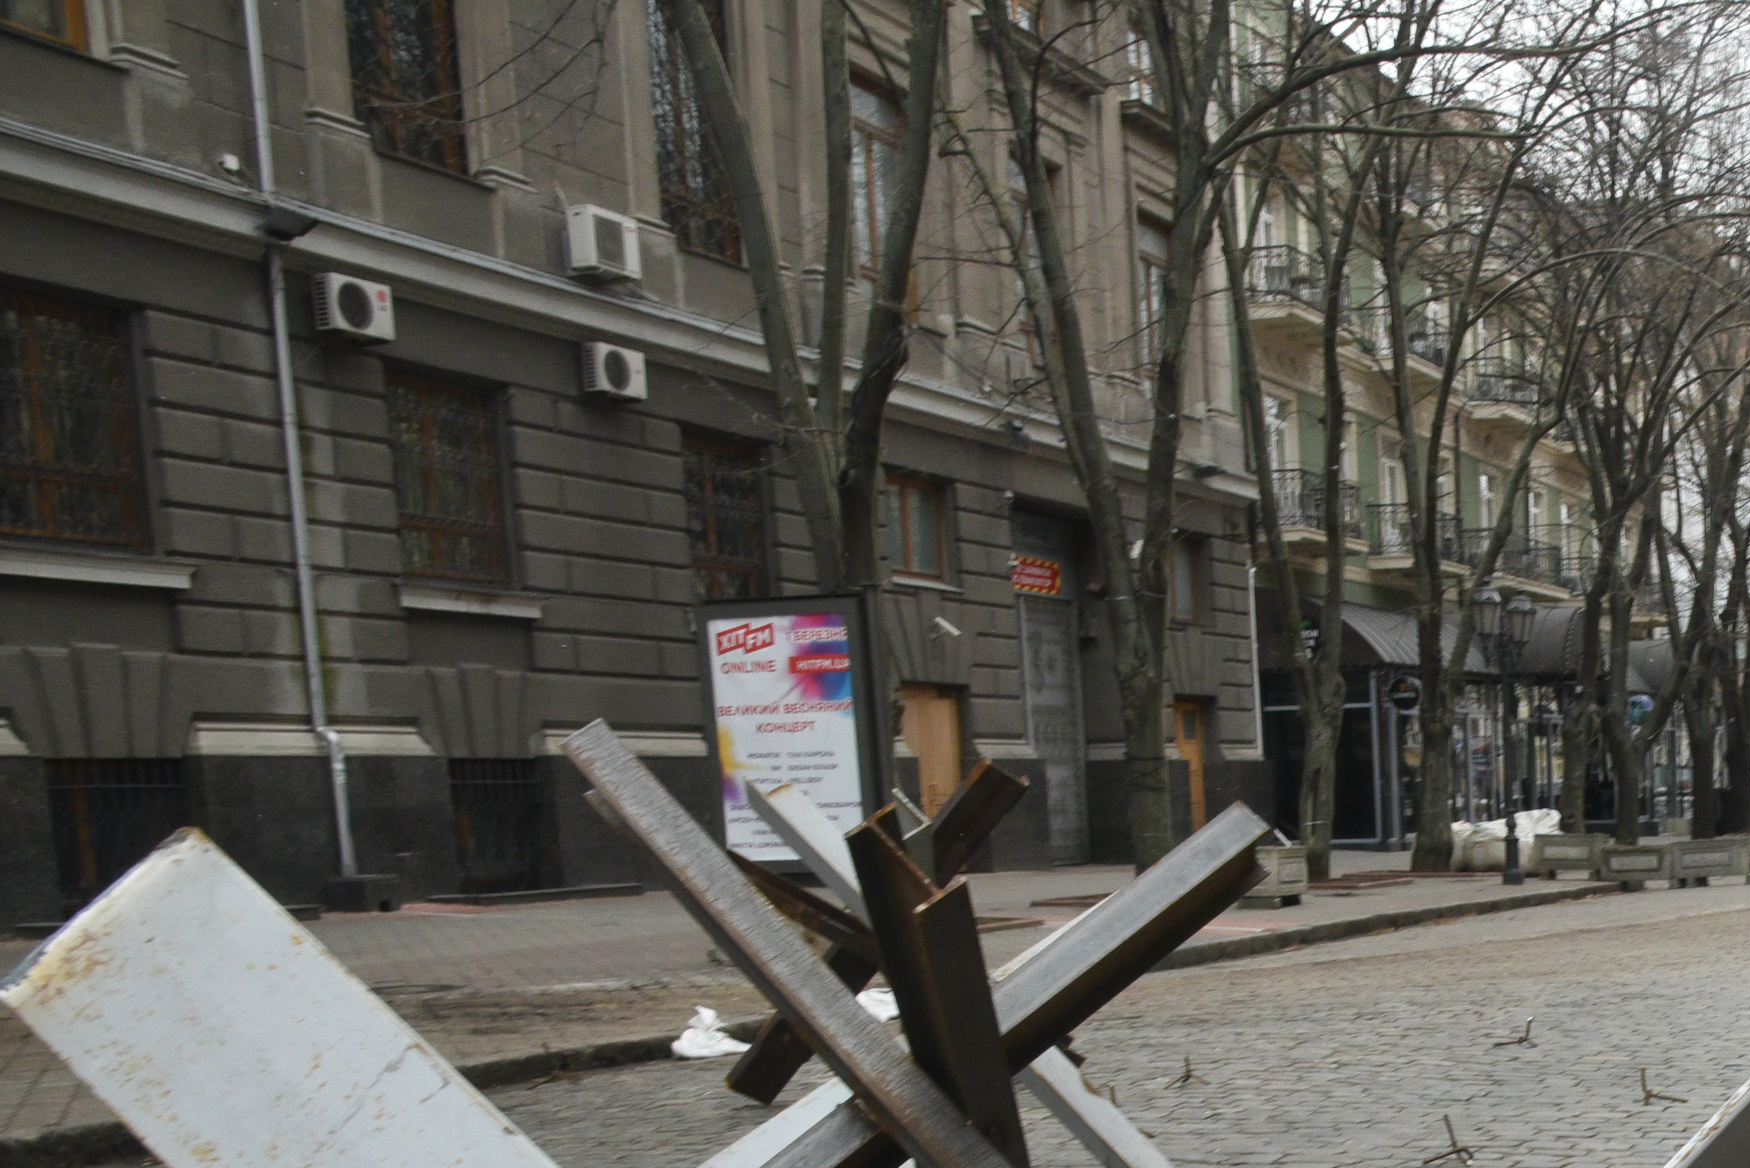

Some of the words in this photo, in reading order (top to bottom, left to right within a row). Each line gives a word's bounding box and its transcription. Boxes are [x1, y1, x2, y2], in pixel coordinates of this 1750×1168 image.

[720, 660, 776, 674] ONLINE
[718, 701, 780, 716] ВЕЛИКИЙ
[784, 697, 853, 714] ВЕСНЯНИЙ
[756, 720, 816, 733] КОНЦЕРТ
